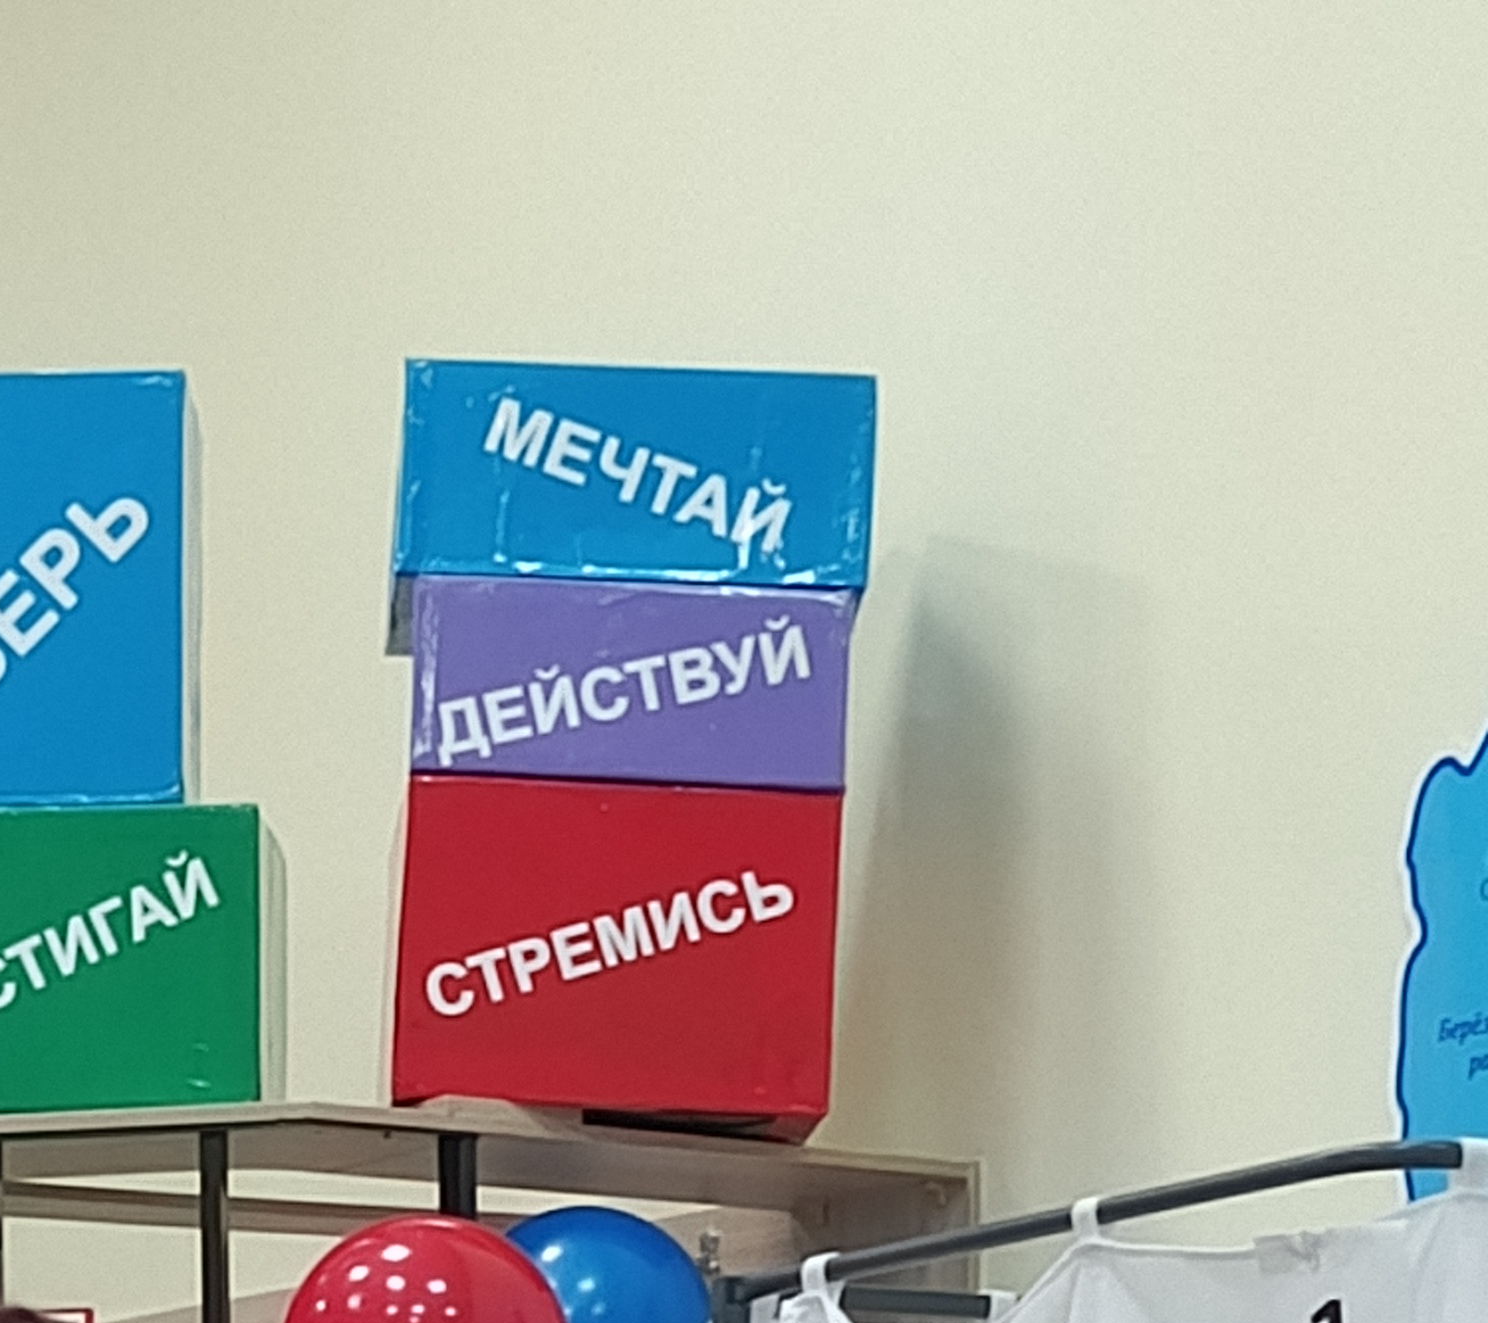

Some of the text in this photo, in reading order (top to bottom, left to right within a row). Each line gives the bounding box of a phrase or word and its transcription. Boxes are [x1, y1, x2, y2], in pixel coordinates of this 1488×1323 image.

[483, 397, 792, 562] МЕЧТАЙ
[436, 613, 812, 768] ДЕЙСТВУЙ
[425, 870, 795, 1017] СТРЕМИСЬ
